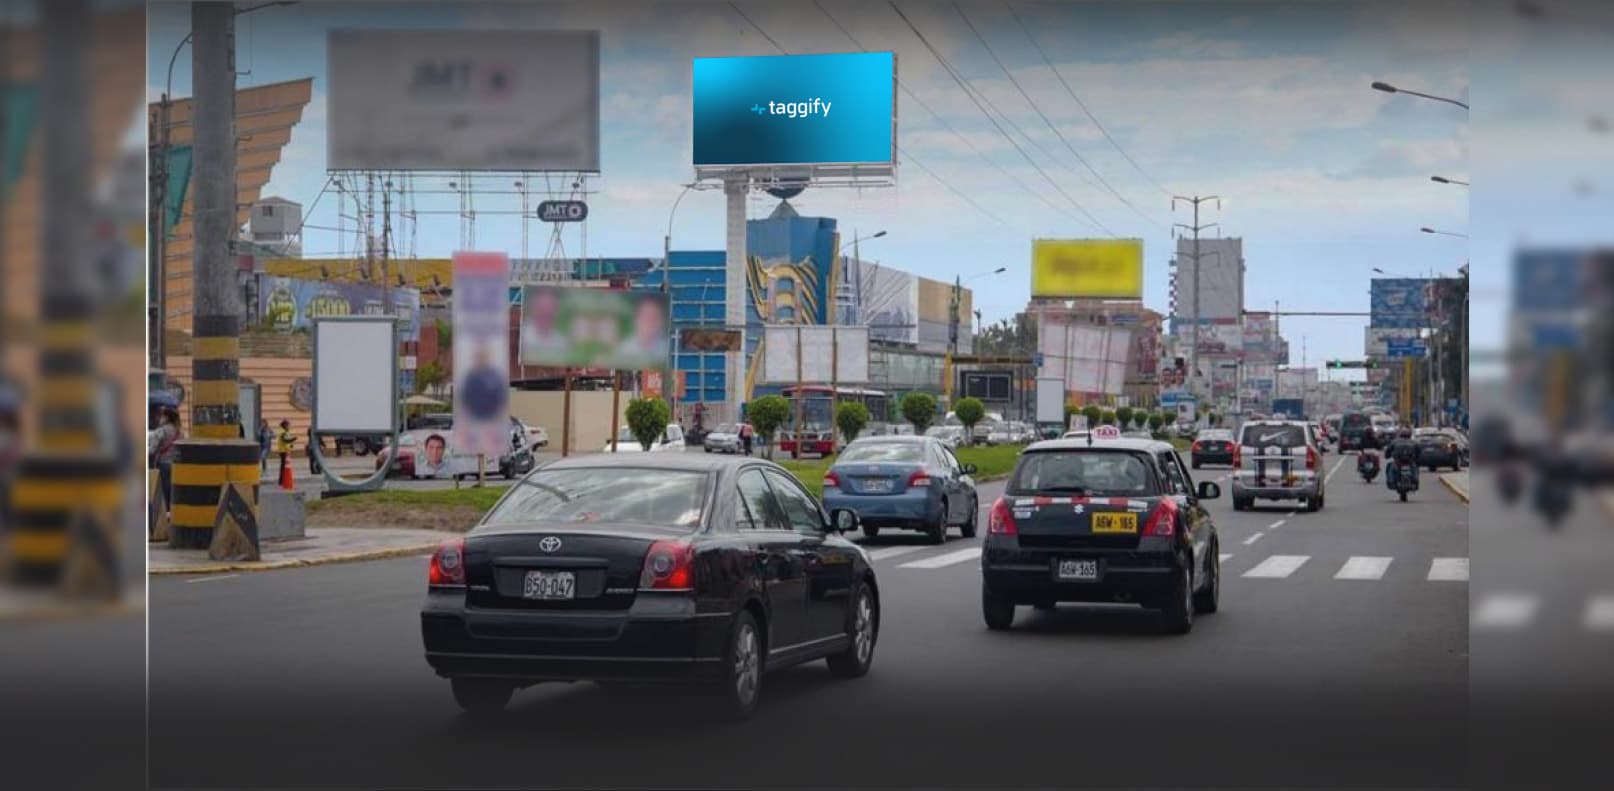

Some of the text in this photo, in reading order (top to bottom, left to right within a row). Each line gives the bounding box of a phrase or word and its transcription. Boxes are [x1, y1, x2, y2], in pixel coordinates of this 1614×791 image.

[769, 98, 831, 118] taggify
[544, 204, 568, 218] JMT
[1097, 428, 1118, 438] TAXI
